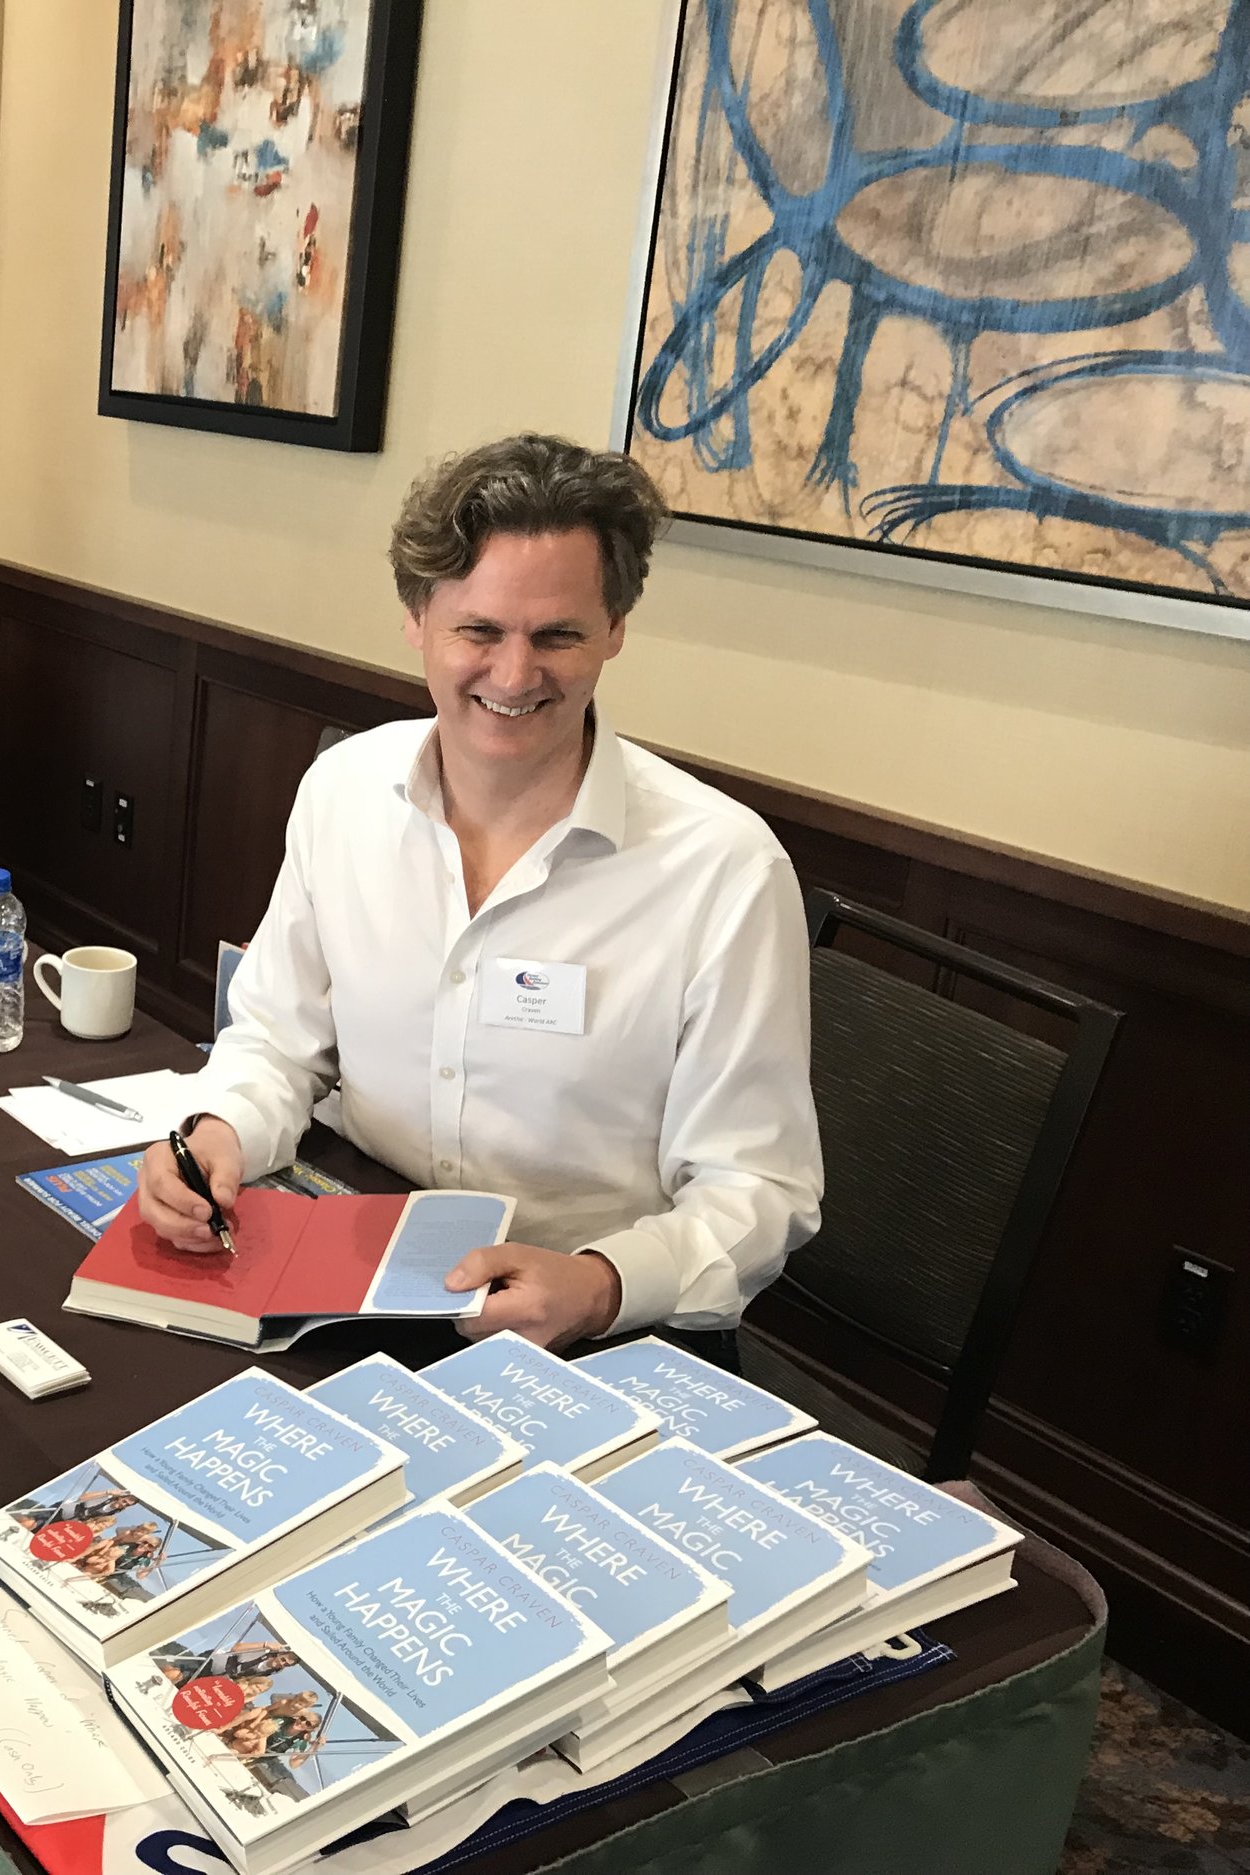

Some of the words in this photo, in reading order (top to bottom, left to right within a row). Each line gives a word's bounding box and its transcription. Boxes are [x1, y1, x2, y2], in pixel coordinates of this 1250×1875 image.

[516, 995, 546, 1005] Casper
[380, 1372, 429, 1408] CASPAR
[430, 1408, 486, 1446] CRAVEN
[462, 1384, 548, 1437] MAGIC
[500, 1363, 591, 1419] WHERE
[508, 1347, 559, 1379] CASPAR
[562, 1378, 620, 1414] CRAVEN
[512, 1393, 535, 1409] THE
[619, 1376, 709, 1421] MAGIC
[654, 1363, 746, 1411] WHERE
[243, 1402, 333, 1461] WHERE
[253, 1386, 304, 1419] CASPAR
[307, 1417, 363, 1452] CRAVEN
[253, 1436, 277, 1453] THE
[368, 1389, 456, 1452] WHERE
[378, 1424, 400, 1441] THE
[164, 1436, 273, 1508] HAPPENS
[202, 1429, 287, 1483] MAGIC
[145, 1465, 158, 1473] and
[157, 1470, 173, 1485] Sailed
[172, 1482, 198, 1498] Around
[193, 1496, 205, 1506] the
[205, 1504, 226, 1518] World
[160, 1460, 176, 1475] Young
[175, 1472, 194, 1485] Family
[194, 1484, 222, 1502] Changed
[221, 1499, 236, 1512] Their
[234, 1510, 251, 1524] Lives
[678, 1477, 788, 1550] WHERE
[684, 1458, 745, 1499] CASPAR
[751, 1499, 821, 1545] CRAVEN
[795, 1480, 901, 1538] MAGIC
[830, 1463, 941, 1526] WHERE
[851, 1493, 879, 1509] THE
[541, 1505, 648, 1586] WHERE
[550, 1484, 611, 1530] CASPAR
[614, 1530, 681, 1580] CRAVEN
[638, 1503, 743, 1571] MAGIC
[695, 1515, 724, 1536] THE
[426, 1546, 528, 1634] WHERE
[441, 1526, 497, 1575] CASPAR
[498, 1575, 562, 1629] CRAVEN
[500, 1533, 598, 1609] MAGIC
[555, 1547, 583, 1570] THE
[334, 1581, 454, 1687] HAPPENS
[377, 1576, 473, 1656] MAGIC
[435, 1592, 462, 1615] THE
[306, 1590, 324, 1608] How
[326, 1610, 345, 1631] Young
[344, 1627, 365, 1648] Family
[364, 1647, 395, 1675] Changed
[389, 1671, 408, 1690] Their
[407, 1689, 426, 1709] Lives
[310, 1615, 324, 1627] and
[321, 1625, 344, 1644] Sailed
[338, 1642, 363, 1666] Around
[361, 1665, 374, 1677] the
[373, 1674, 397, 1697] World
